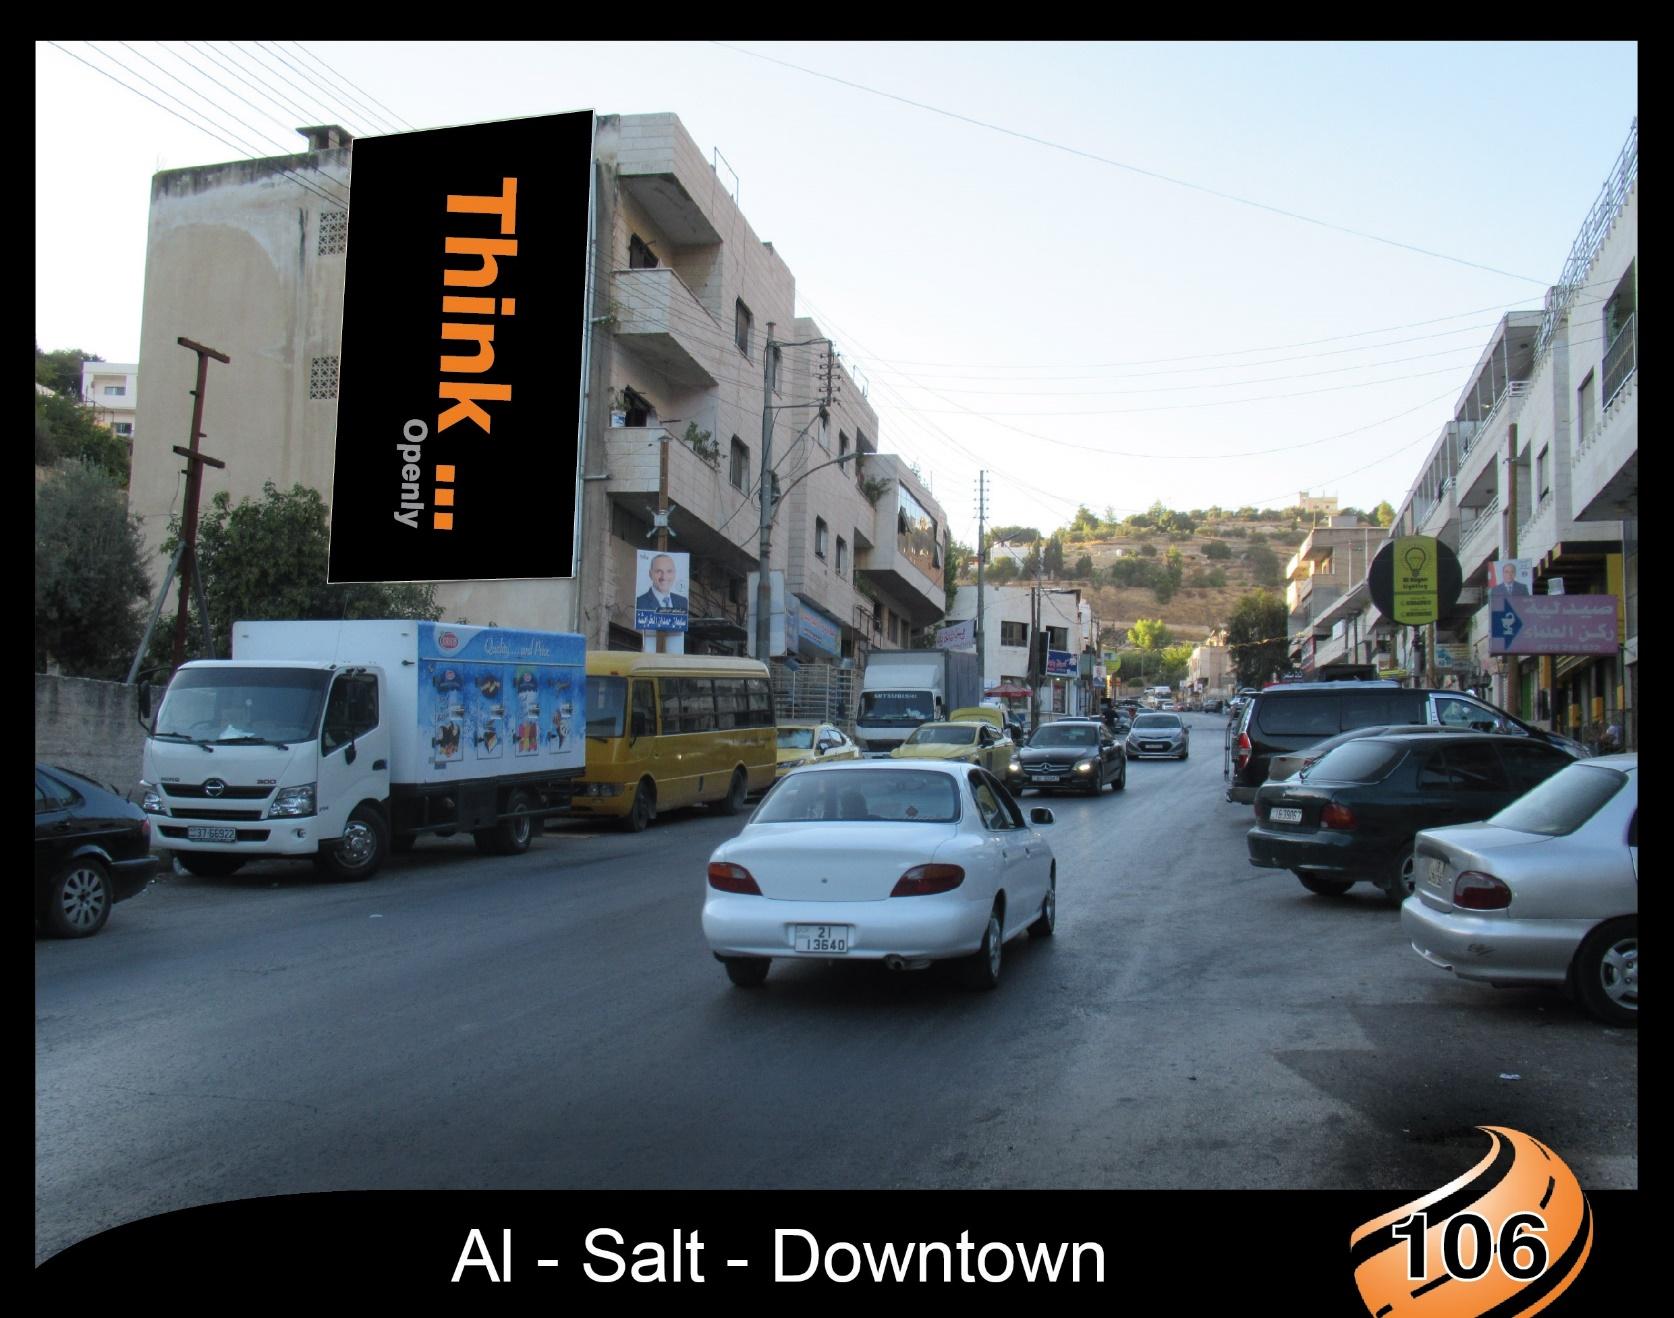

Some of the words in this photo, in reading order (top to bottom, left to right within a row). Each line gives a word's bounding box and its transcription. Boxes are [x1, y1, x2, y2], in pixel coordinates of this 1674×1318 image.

[437, 177, 519, 434] Think
[393, 418, 429, 529] Openly
[807, 938, 845, 950] 13640
[817, 926, 831, 938] 21
